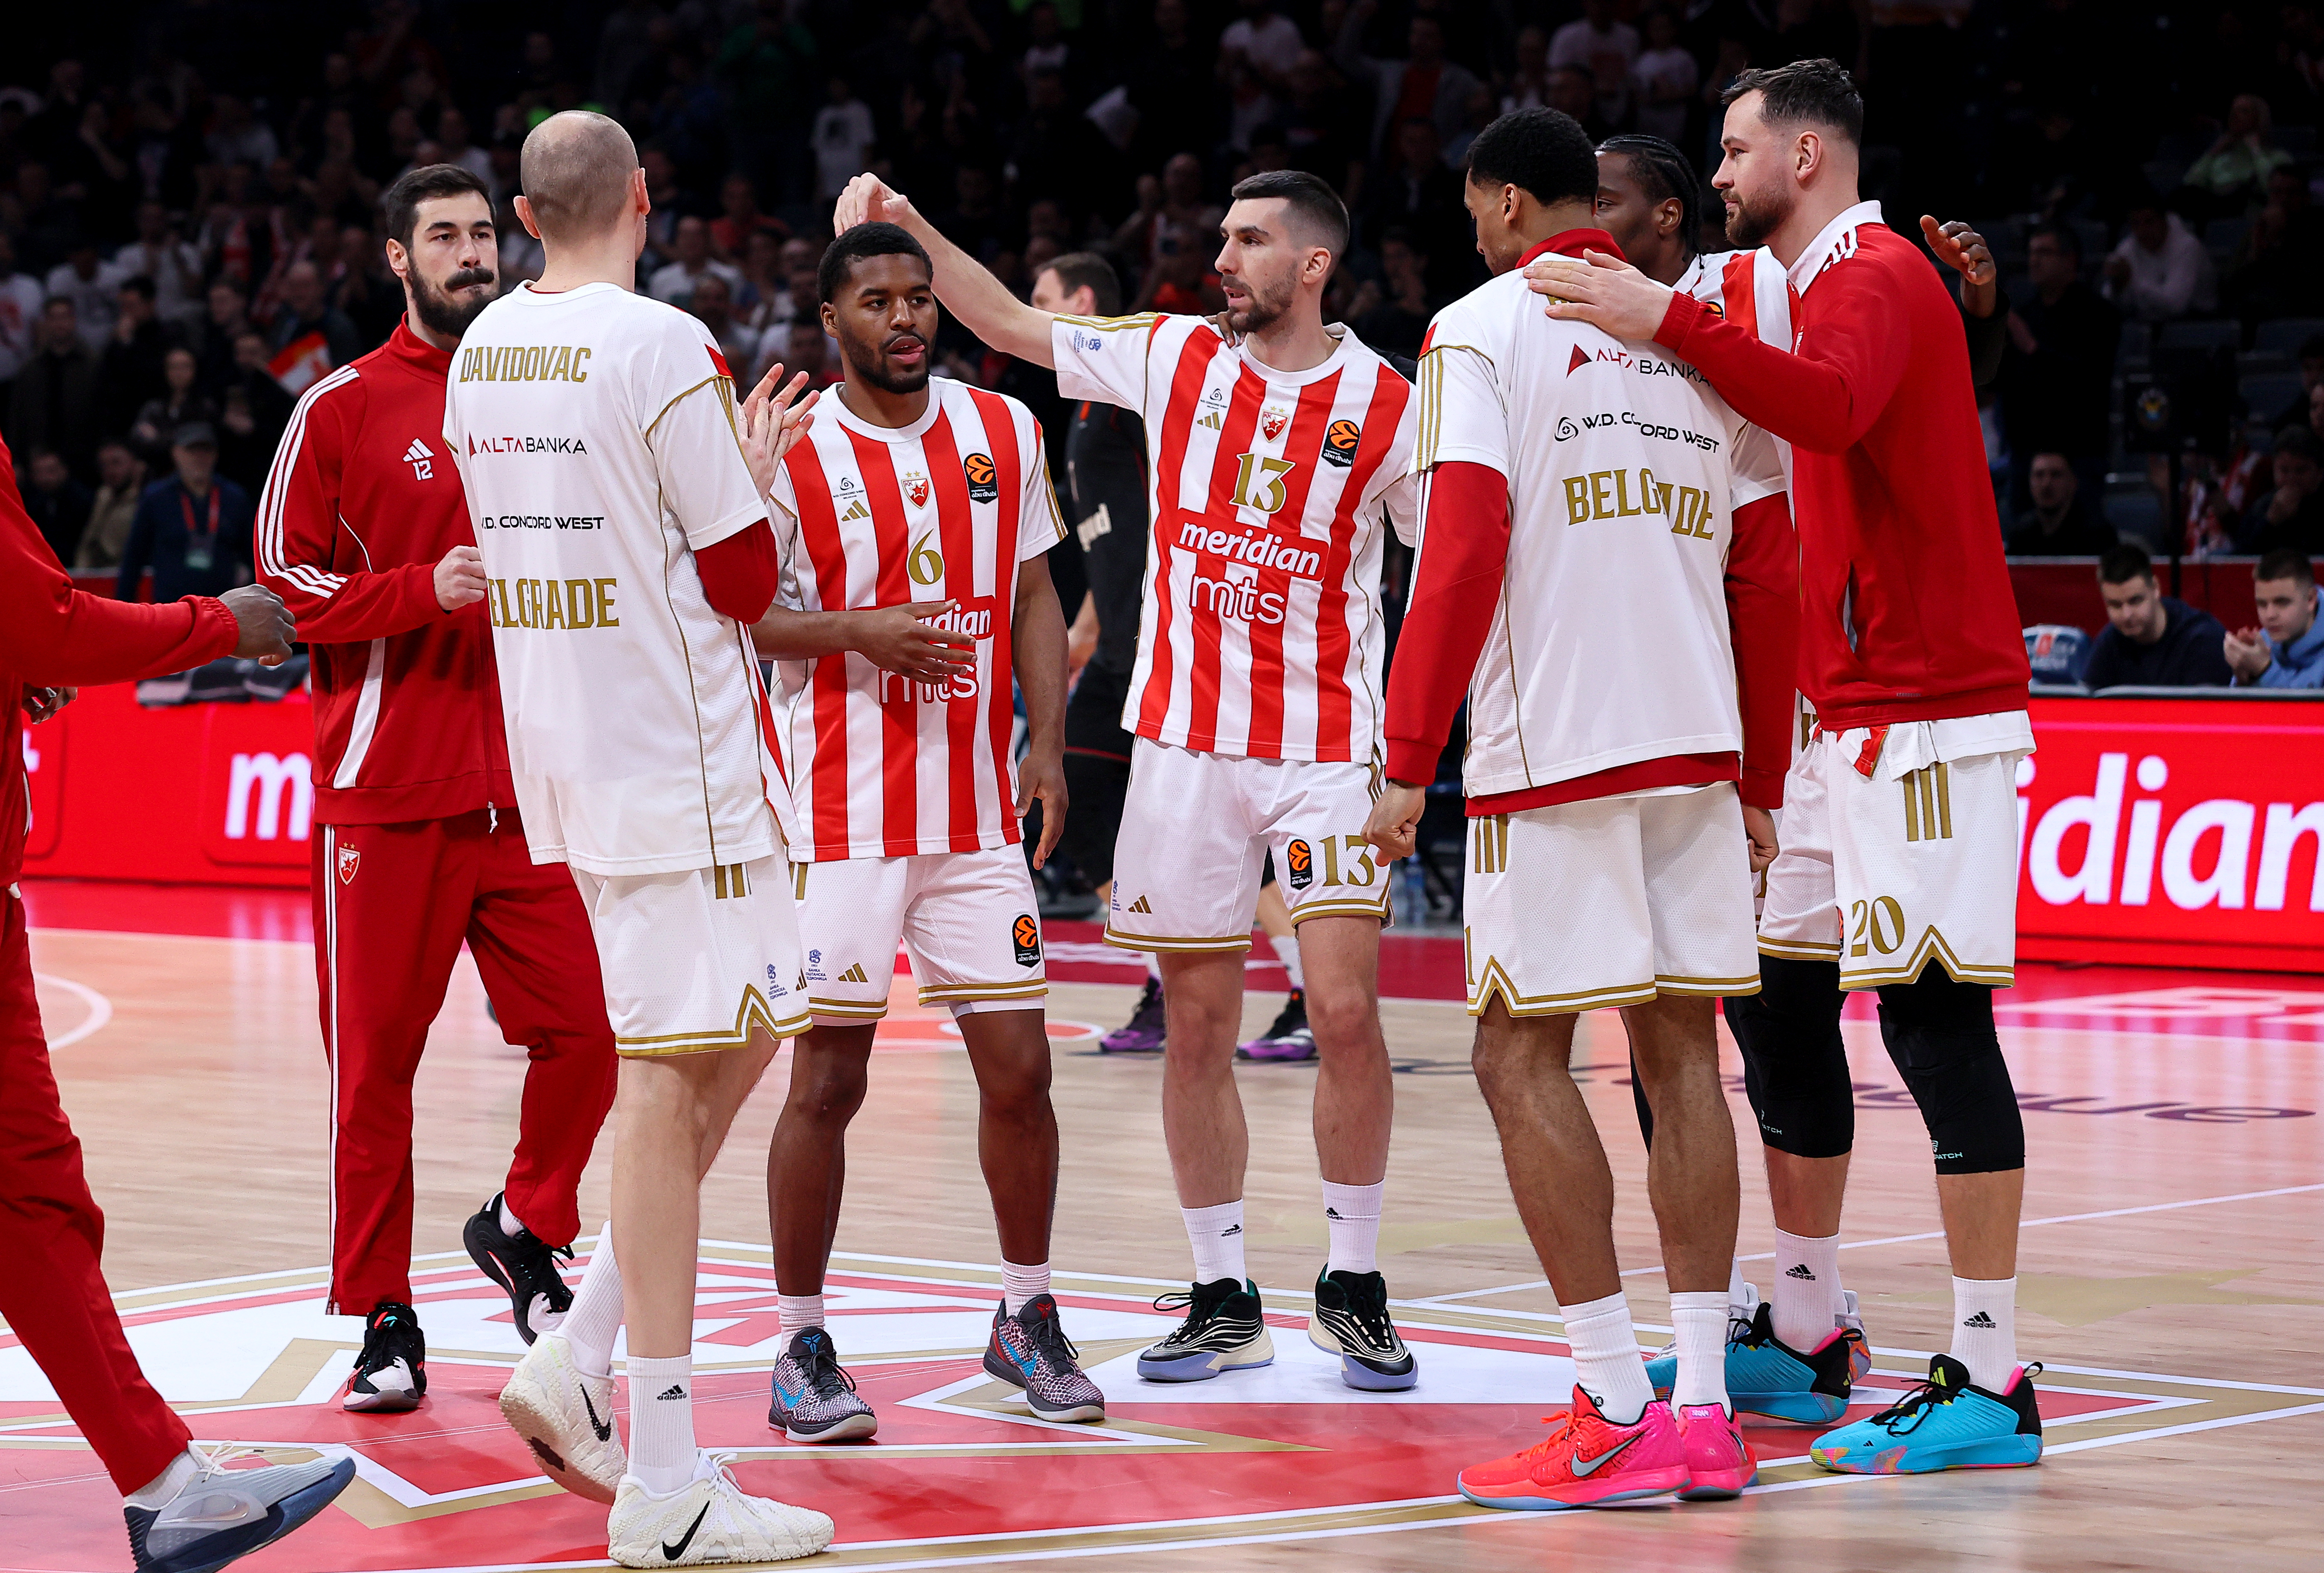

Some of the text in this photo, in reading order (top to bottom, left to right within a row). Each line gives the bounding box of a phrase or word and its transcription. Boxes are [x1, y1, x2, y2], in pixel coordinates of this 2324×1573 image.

[459, 346, 591, 382] DAVIDOVAC
[1596, 348, 1711, 387] ALTABANKA
[481, 437, 587, 455] ALTABANKA
[1582, 413, 1617, 429] W.D.
[1682, 430, 1720, 454] WEST
[413, 459, 433, 481] 12
[1335, 455, 1353, 465] dhabi
[1229, 453, 1296, 514] 13
[482, 516, 604, 530] .D. CONCORD WEST
[908, 528, 945, 585] 6
[1179, 522, 1320, 577] meridian
[488, 578, 619, 629] ELGRADE
[1191, 573, 1286, 624] mts
[1318, 835, 1375, 887] 13
[1850, 896, 1905, 957] 20
[1785, 1271, 1816, 1281] adidas
[657, 1392, 687, 1401] adidas
